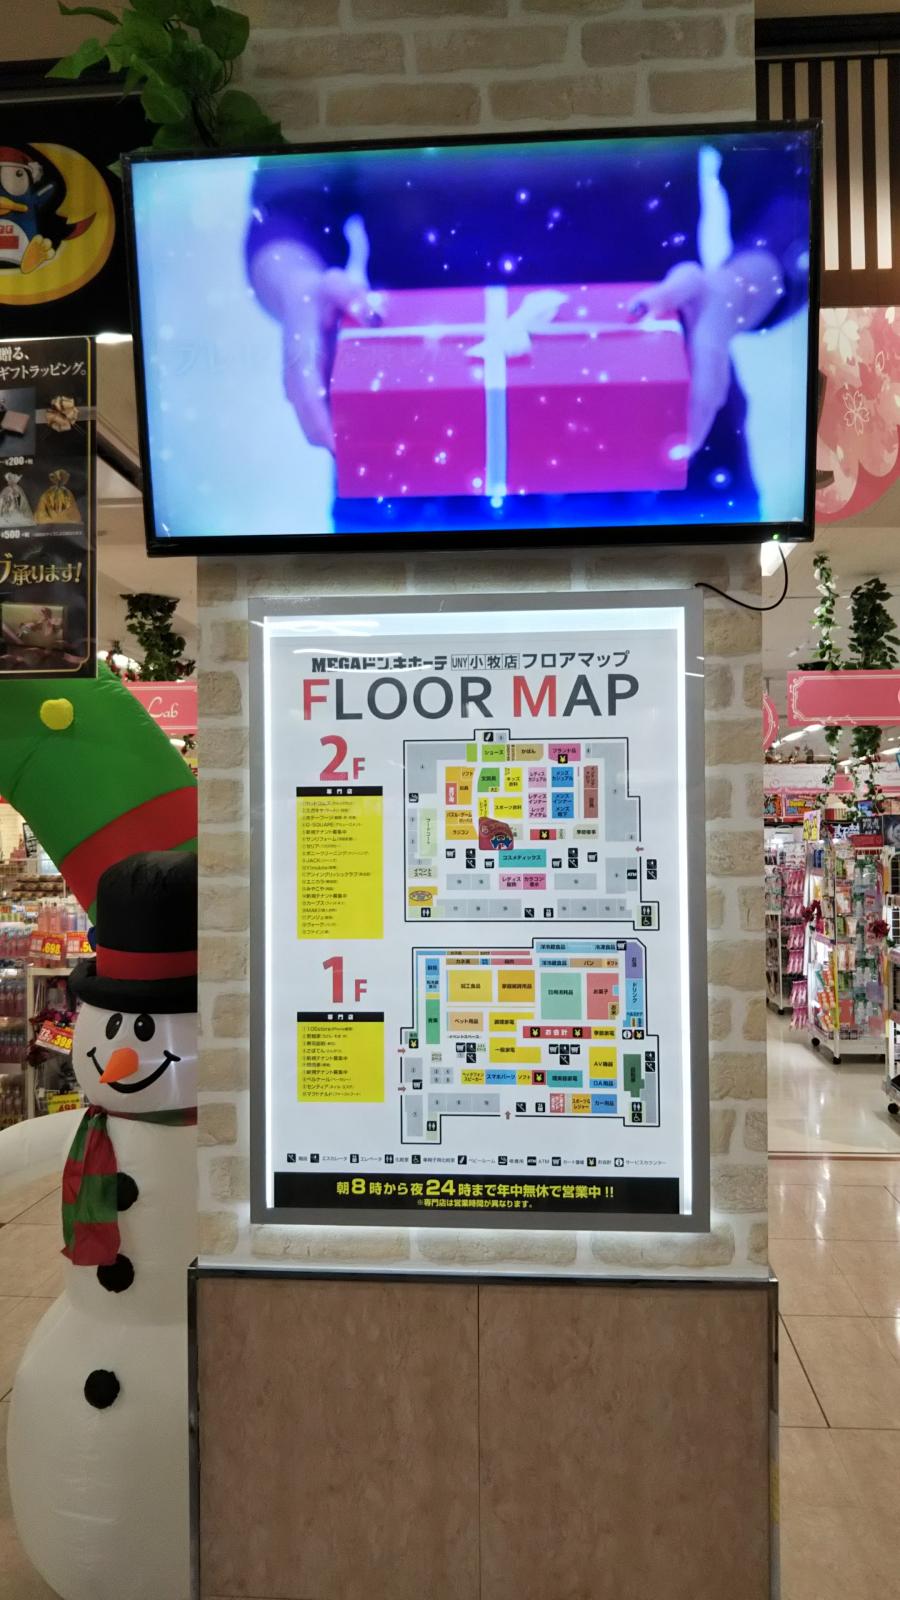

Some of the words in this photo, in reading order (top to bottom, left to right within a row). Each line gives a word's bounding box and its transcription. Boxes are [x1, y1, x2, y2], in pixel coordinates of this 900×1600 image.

[522, 650, 630, 669] フロアマップ
[303, 676, 494, 720] FLOOR
[513, 674, 639, 718] MAP
[320, 735, 366, 781] 2F
[323, 956, 367, 1003] 1F
